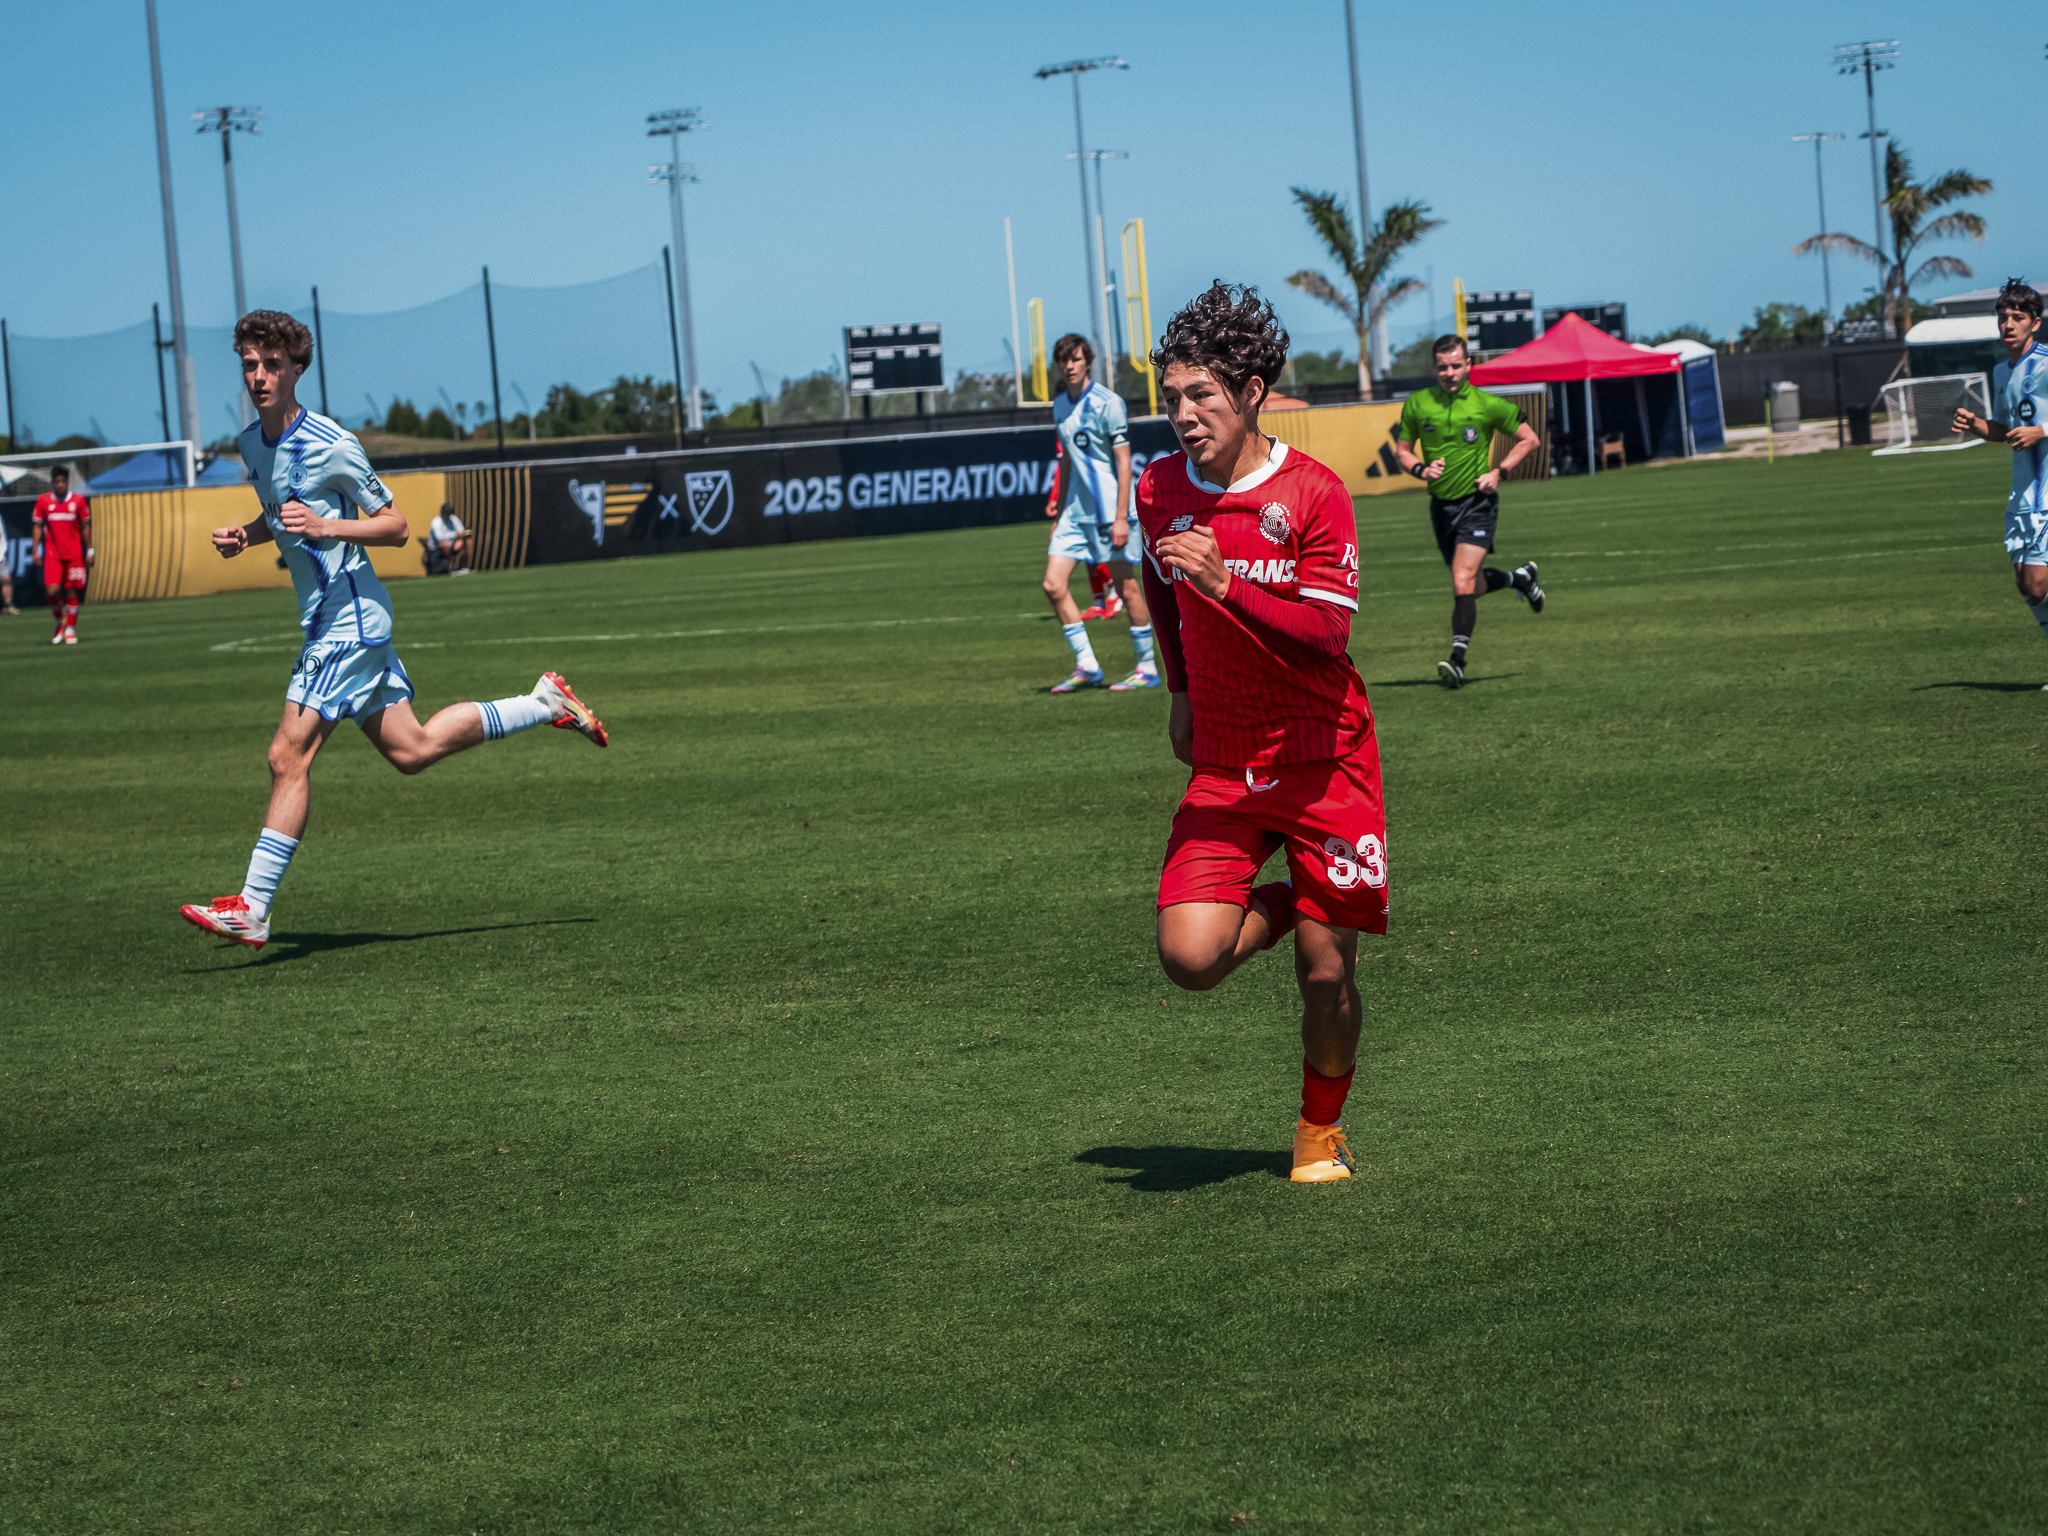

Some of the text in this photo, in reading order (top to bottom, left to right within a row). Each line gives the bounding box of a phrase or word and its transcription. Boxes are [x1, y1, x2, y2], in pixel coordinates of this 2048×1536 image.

[763, 474, 843, 516] 2025
[847, 461, 1040, 510] GENERATION
[1324, 833, 1387, 889] 33
